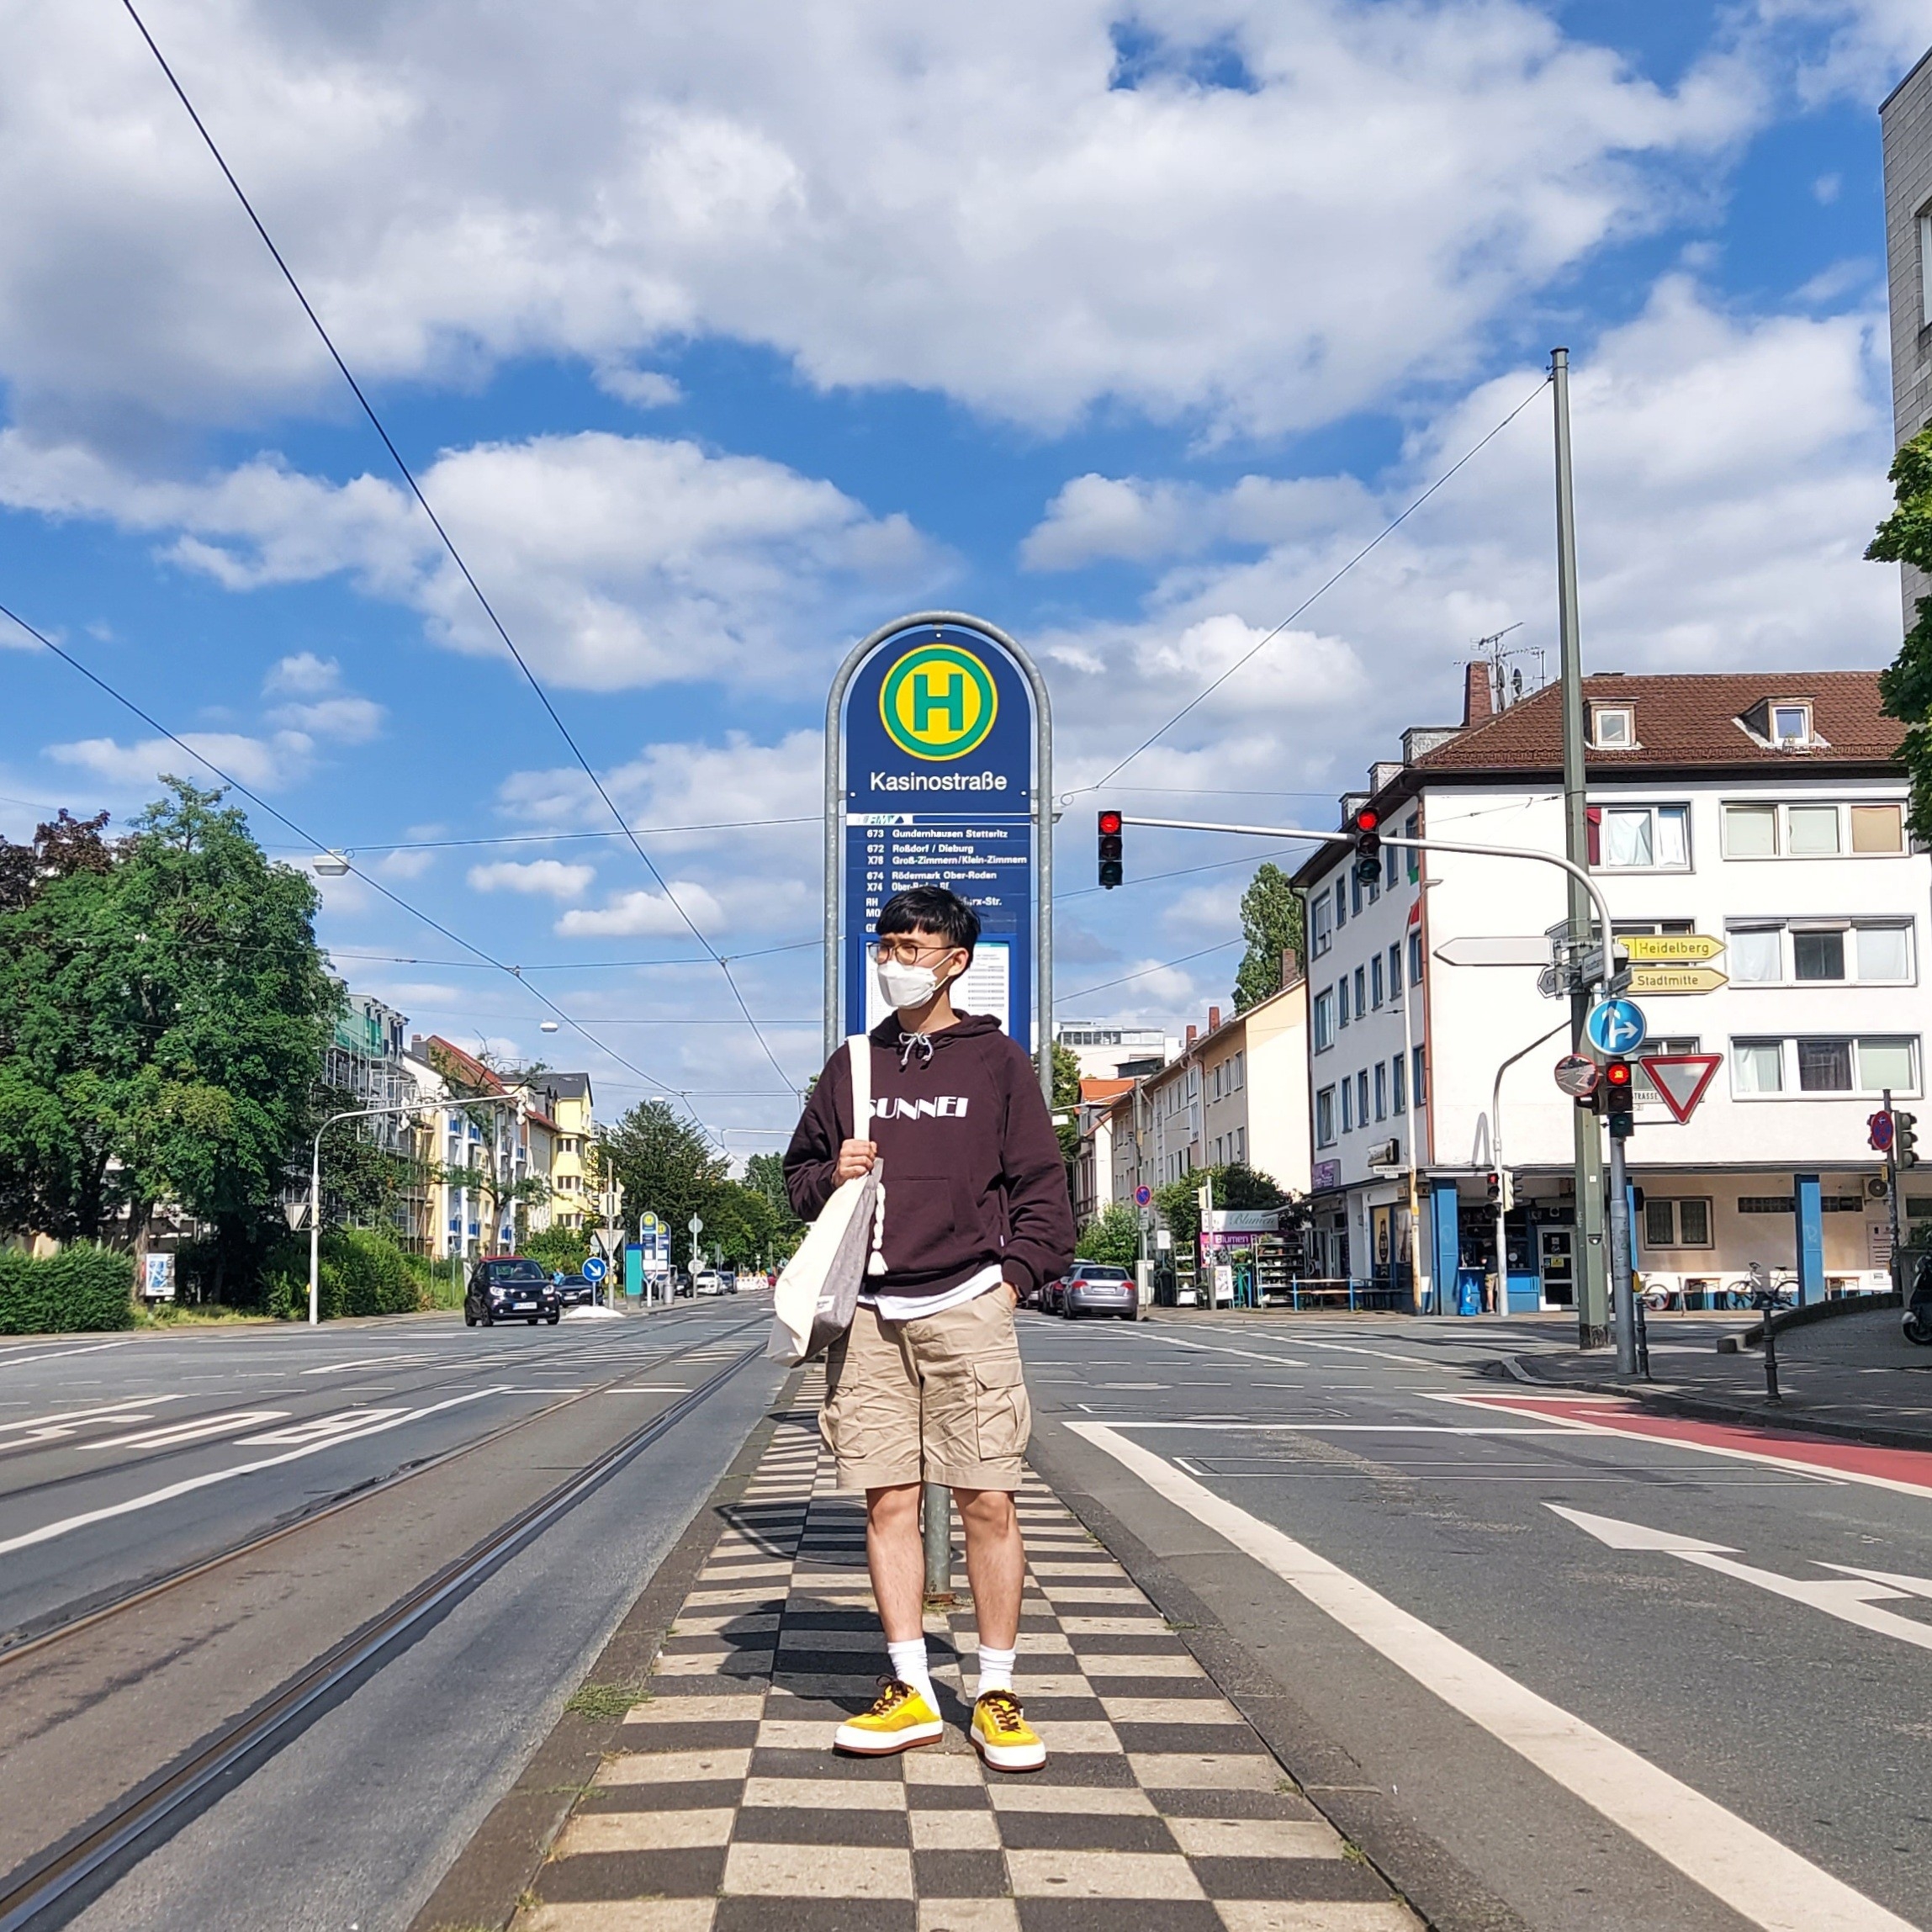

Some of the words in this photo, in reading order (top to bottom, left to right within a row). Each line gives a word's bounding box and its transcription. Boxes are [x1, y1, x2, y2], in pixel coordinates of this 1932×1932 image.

[913, 674, 964, 732] H
[870, 770, 1008, 791] Kasinostraße
[866, 829, 884, 838] 673
[866, 844, 885, 853] 672
[938, 844, 974, 854] Dieburg
[866, 871, 884, 880] 674
[892, 871, 941, 880] Rödermark
[943, 871, 998, 880] Ober-Roden
[867, 882, 883, 892] X74
[865, 897, 879, 907] RH
[865, 908, 881, 918] MO
[1639, 942, 1709, 956] Heidelberg
[1637, 974, 1699, 987] Stadtmitte
[1229, 1213, 1275, 1225] Blumen
[1215, 1234, 1249, 1243] Blumen
